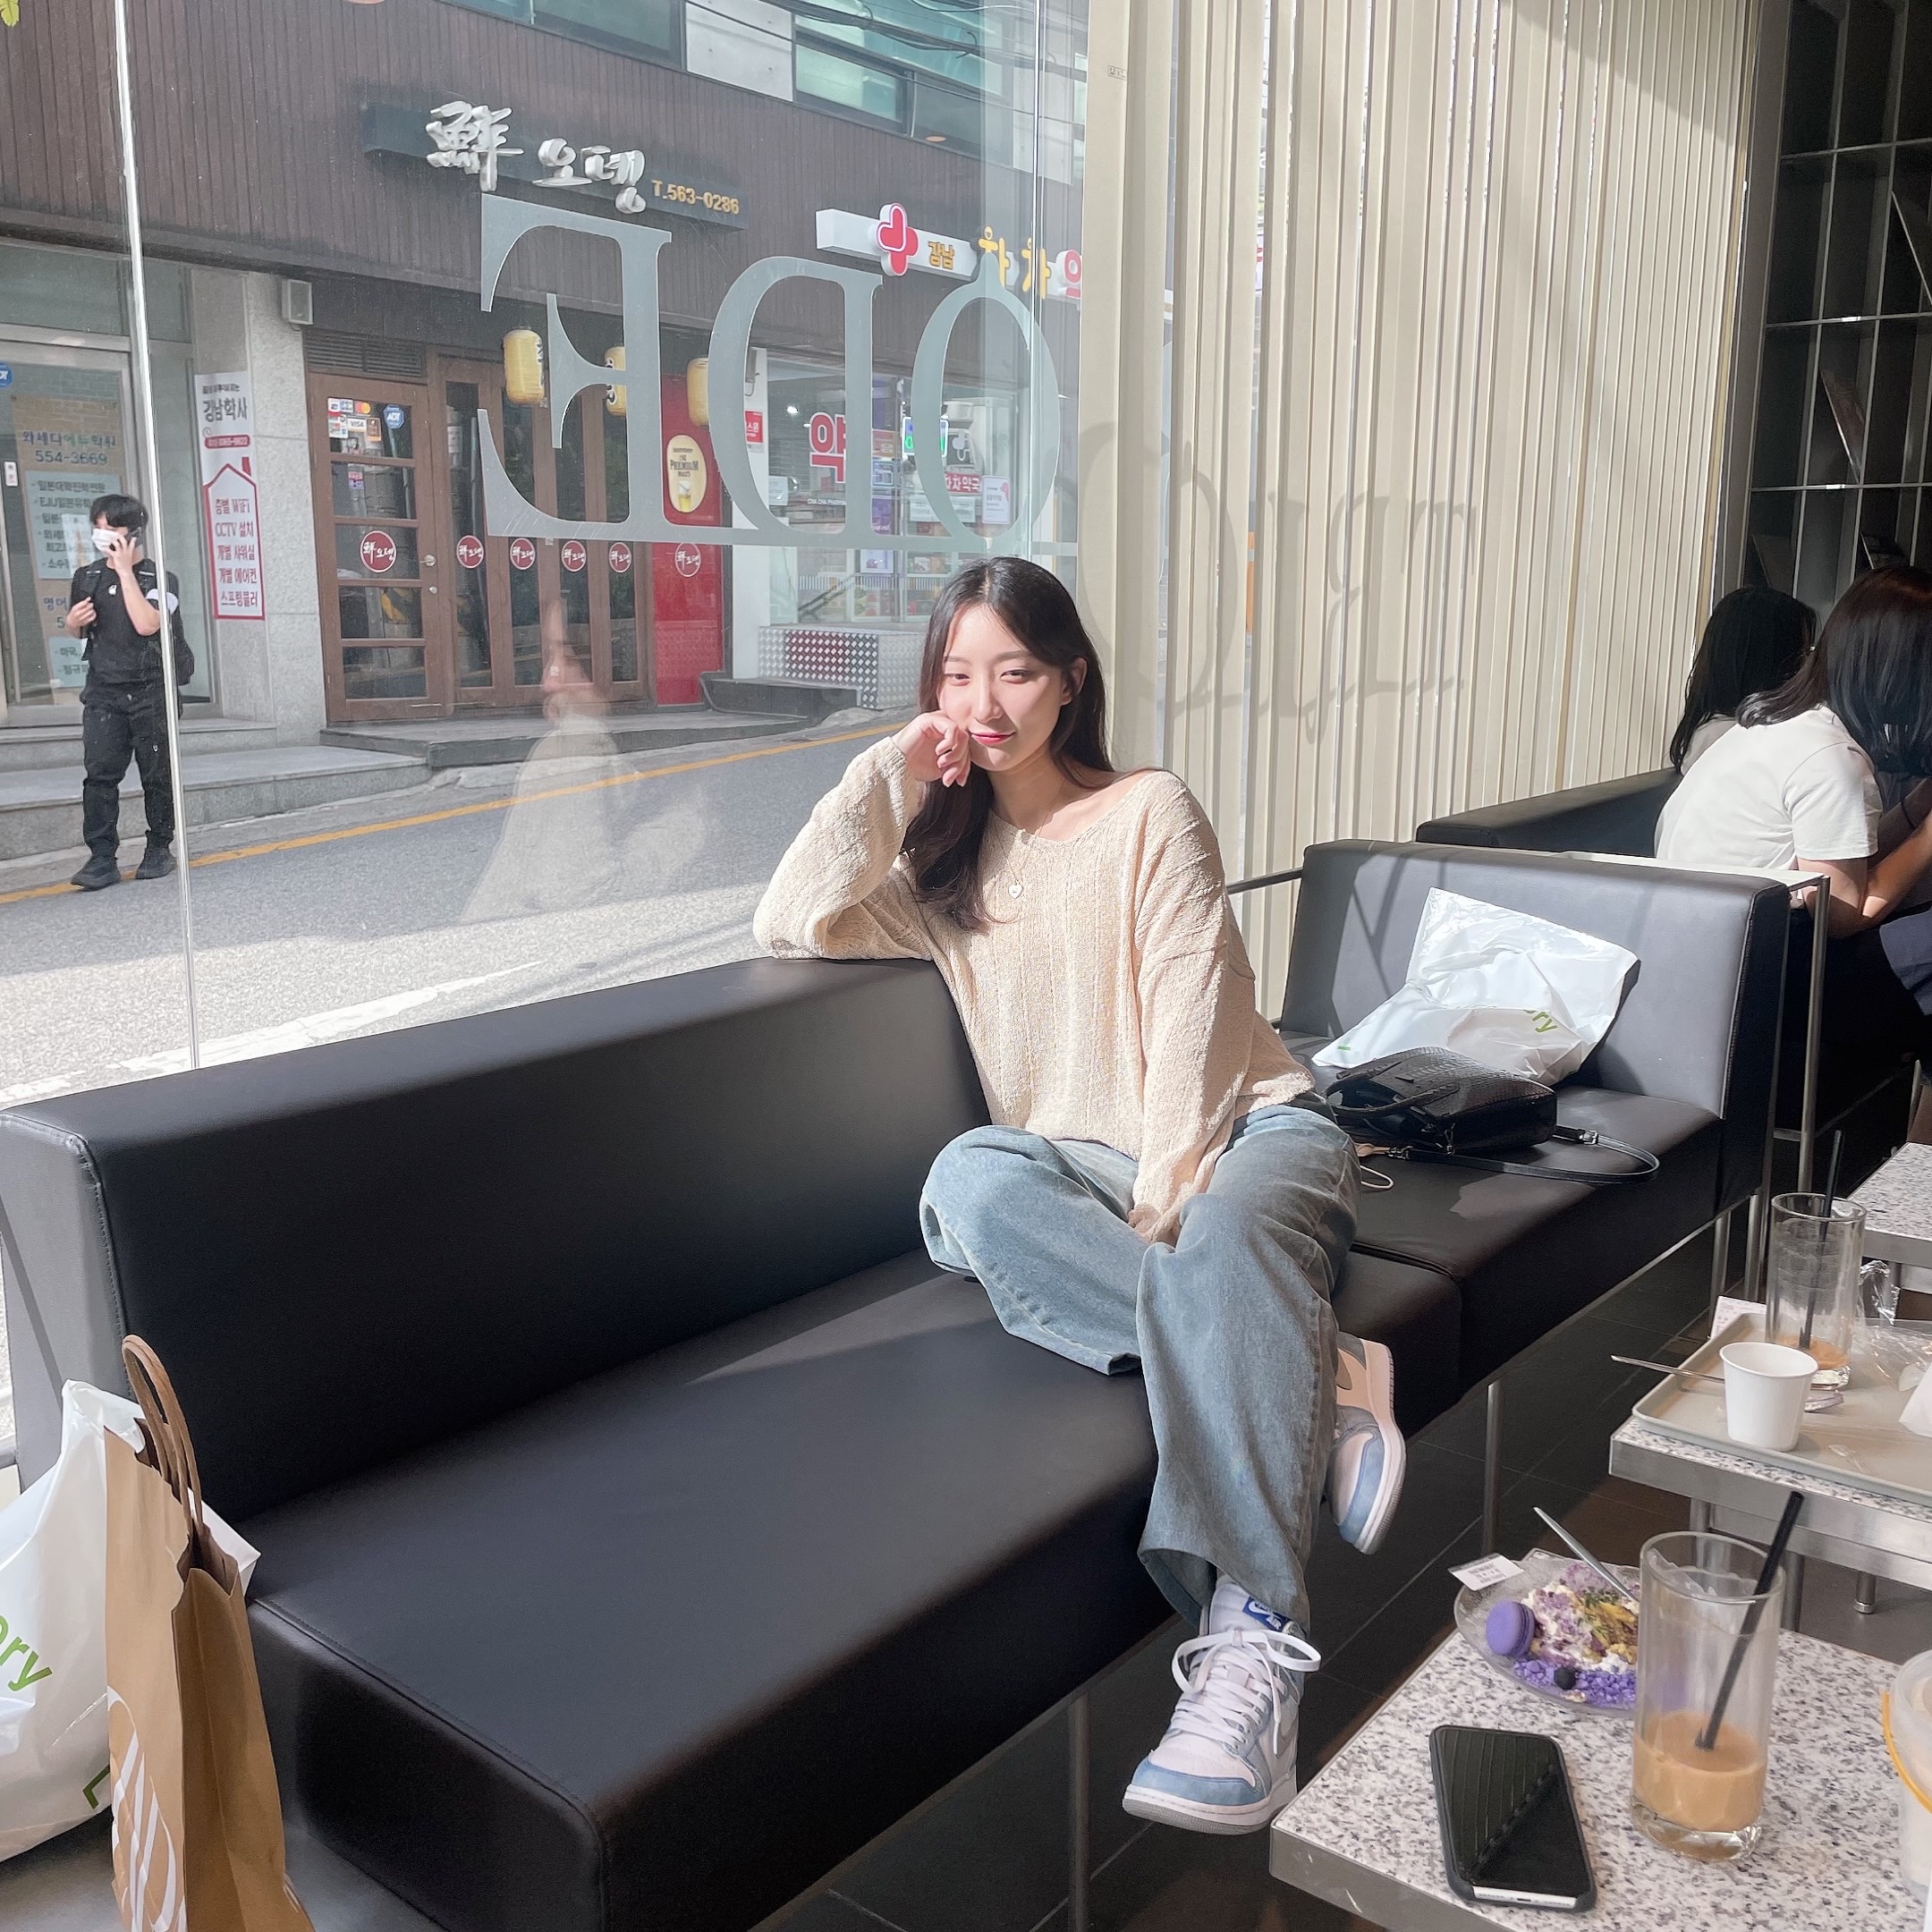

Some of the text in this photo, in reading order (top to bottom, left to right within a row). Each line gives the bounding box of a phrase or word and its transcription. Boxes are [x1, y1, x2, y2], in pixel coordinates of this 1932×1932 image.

[532, 138, 647, 214] 오뎅
[651, 179, 741, 215] T.563-0286
[928, 241, 954, 270] 강남
[203, 397, 248, 422] 강남학사
[35, 449, 108, 465] 554-3669
[215, 498, 250, 514] 층별 WiFi
[215, 521, 254, 538] CCTV 설치
[217, 545, 255, 561] 개별 샤워실
[219, 568, 258, 584] 개별 에어컨
[1523, 1009, 1557, 1032] ry
